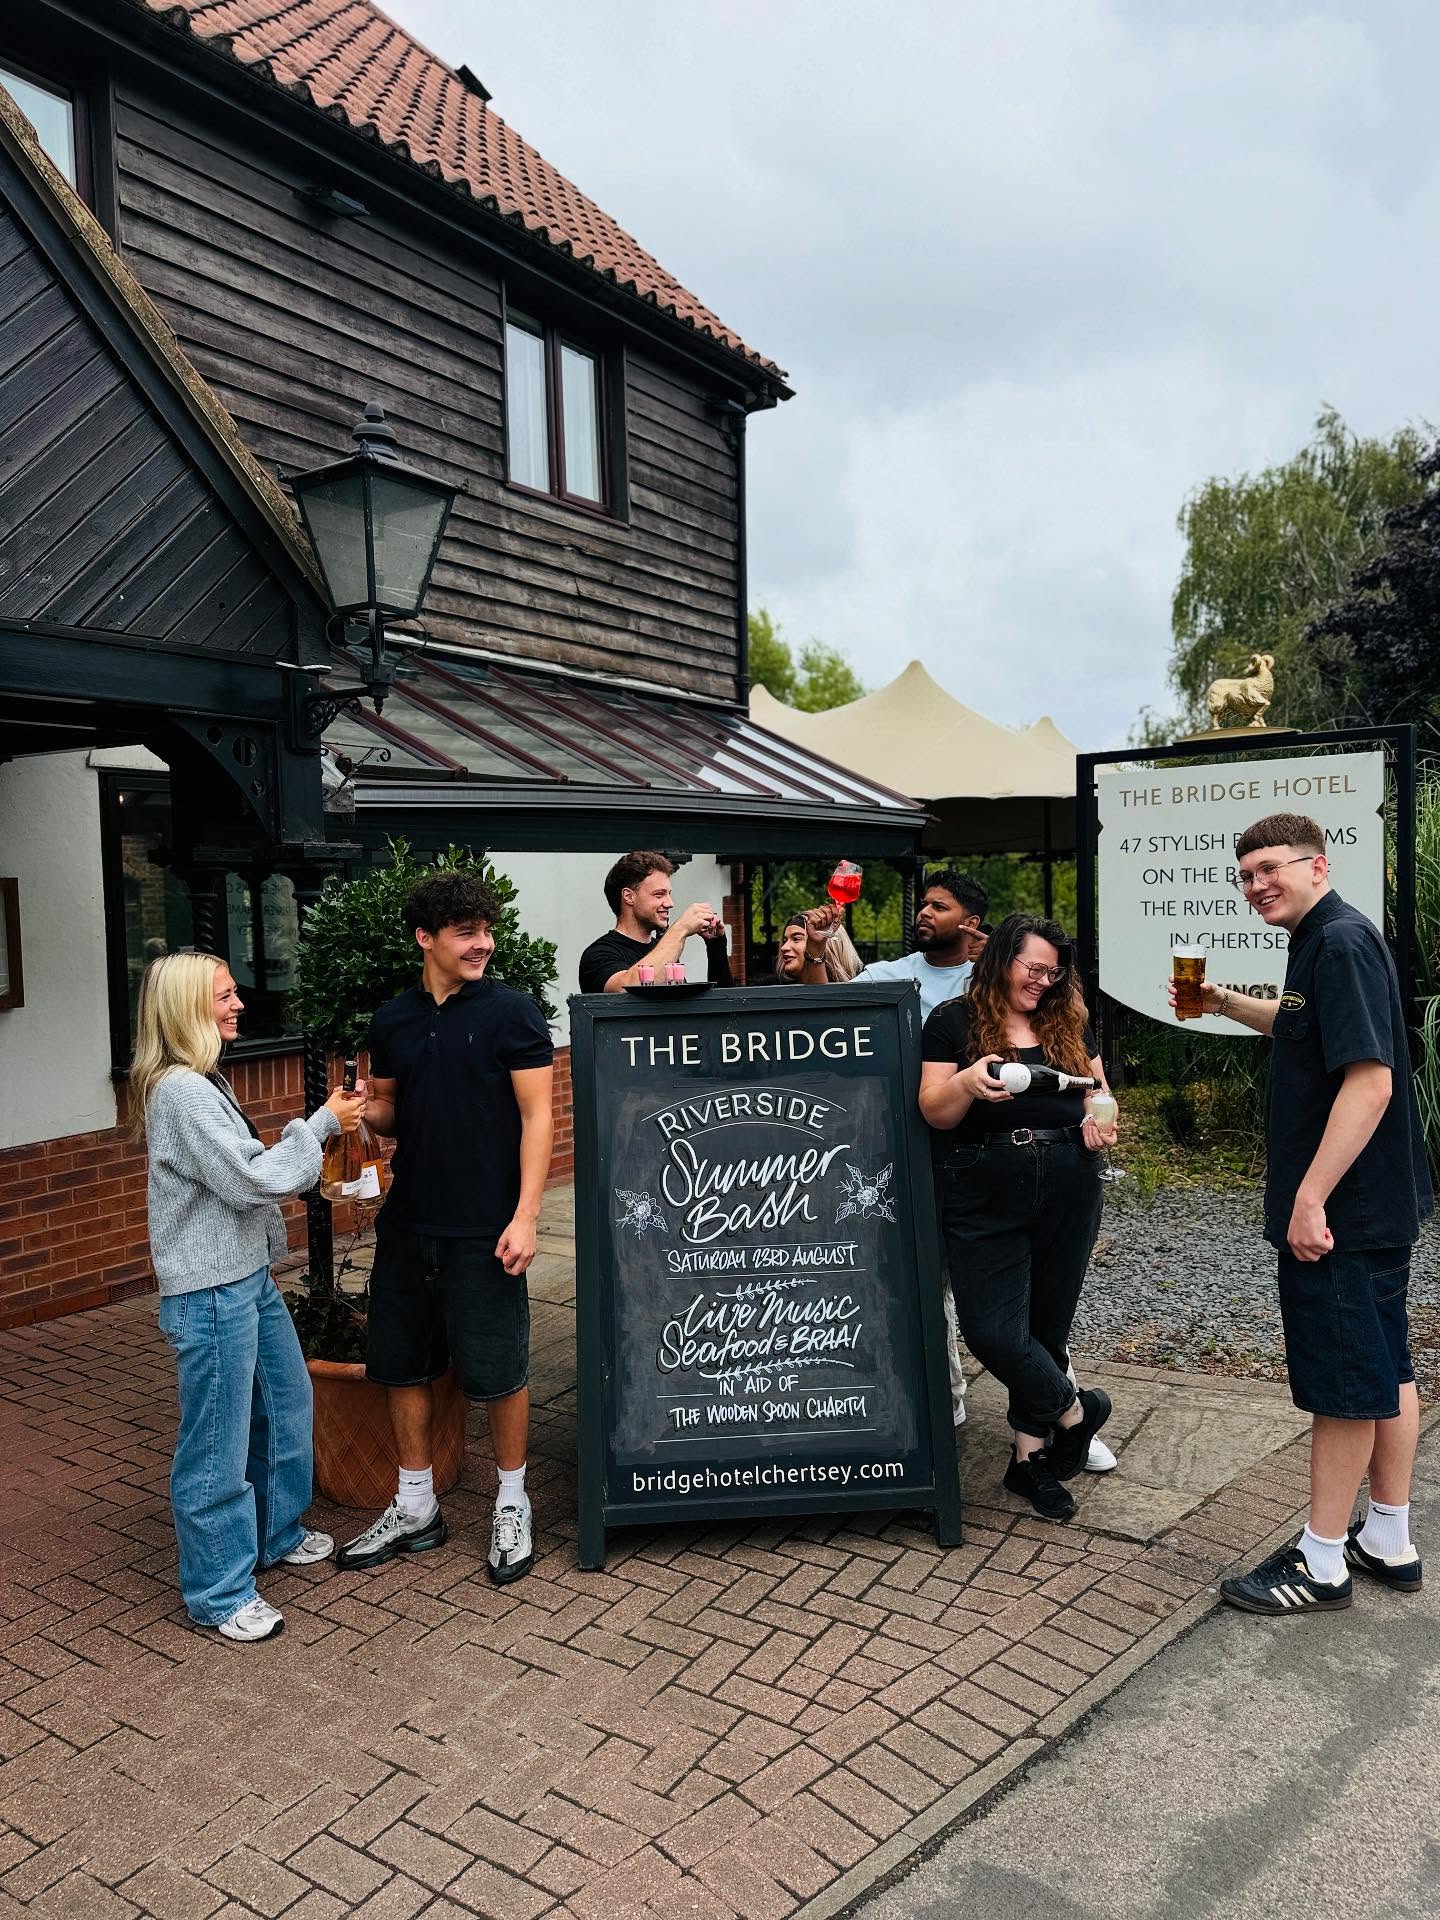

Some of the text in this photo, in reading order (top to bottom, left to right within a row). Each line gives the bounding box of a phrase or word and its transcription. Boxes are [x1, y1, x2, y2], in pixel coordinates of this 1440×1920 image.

[1119, 774, 1357, 808] THE BRIDGE HOTEL
[1119, 837, 1142, 854] 47
[1148, 833, 1225, 853] STYLISH
[1142, 868, 1174, 885] ON
[1181, 866, 1219, 883] THE
[1140, 900, 1177, 917] THE
[1183, 899, 1238, 916] RIVER
[1170, 932, 1189, 948] IN
[621, 1026, 874, 1067] THE BRIDGE
[657, 1092, 830, 1140] RIVERSIDE
[661, 1138, 851, 1208] Summer
[682, 1180, 818, 1243] Bash
[667, 1243, 859, 1273] SATURDAY 23RD AUGUST
[674, 1291, 860, 1337] Live Music
[660, 1320, 778, 1369] Seafood
[719, 1375, 799, 1397] IN AID OF
[669, 1395, 867, 1428] THE WOODEN SPOON CHARITY
[632, 1463, 905, 1494] bridgehotelchertsey.com
